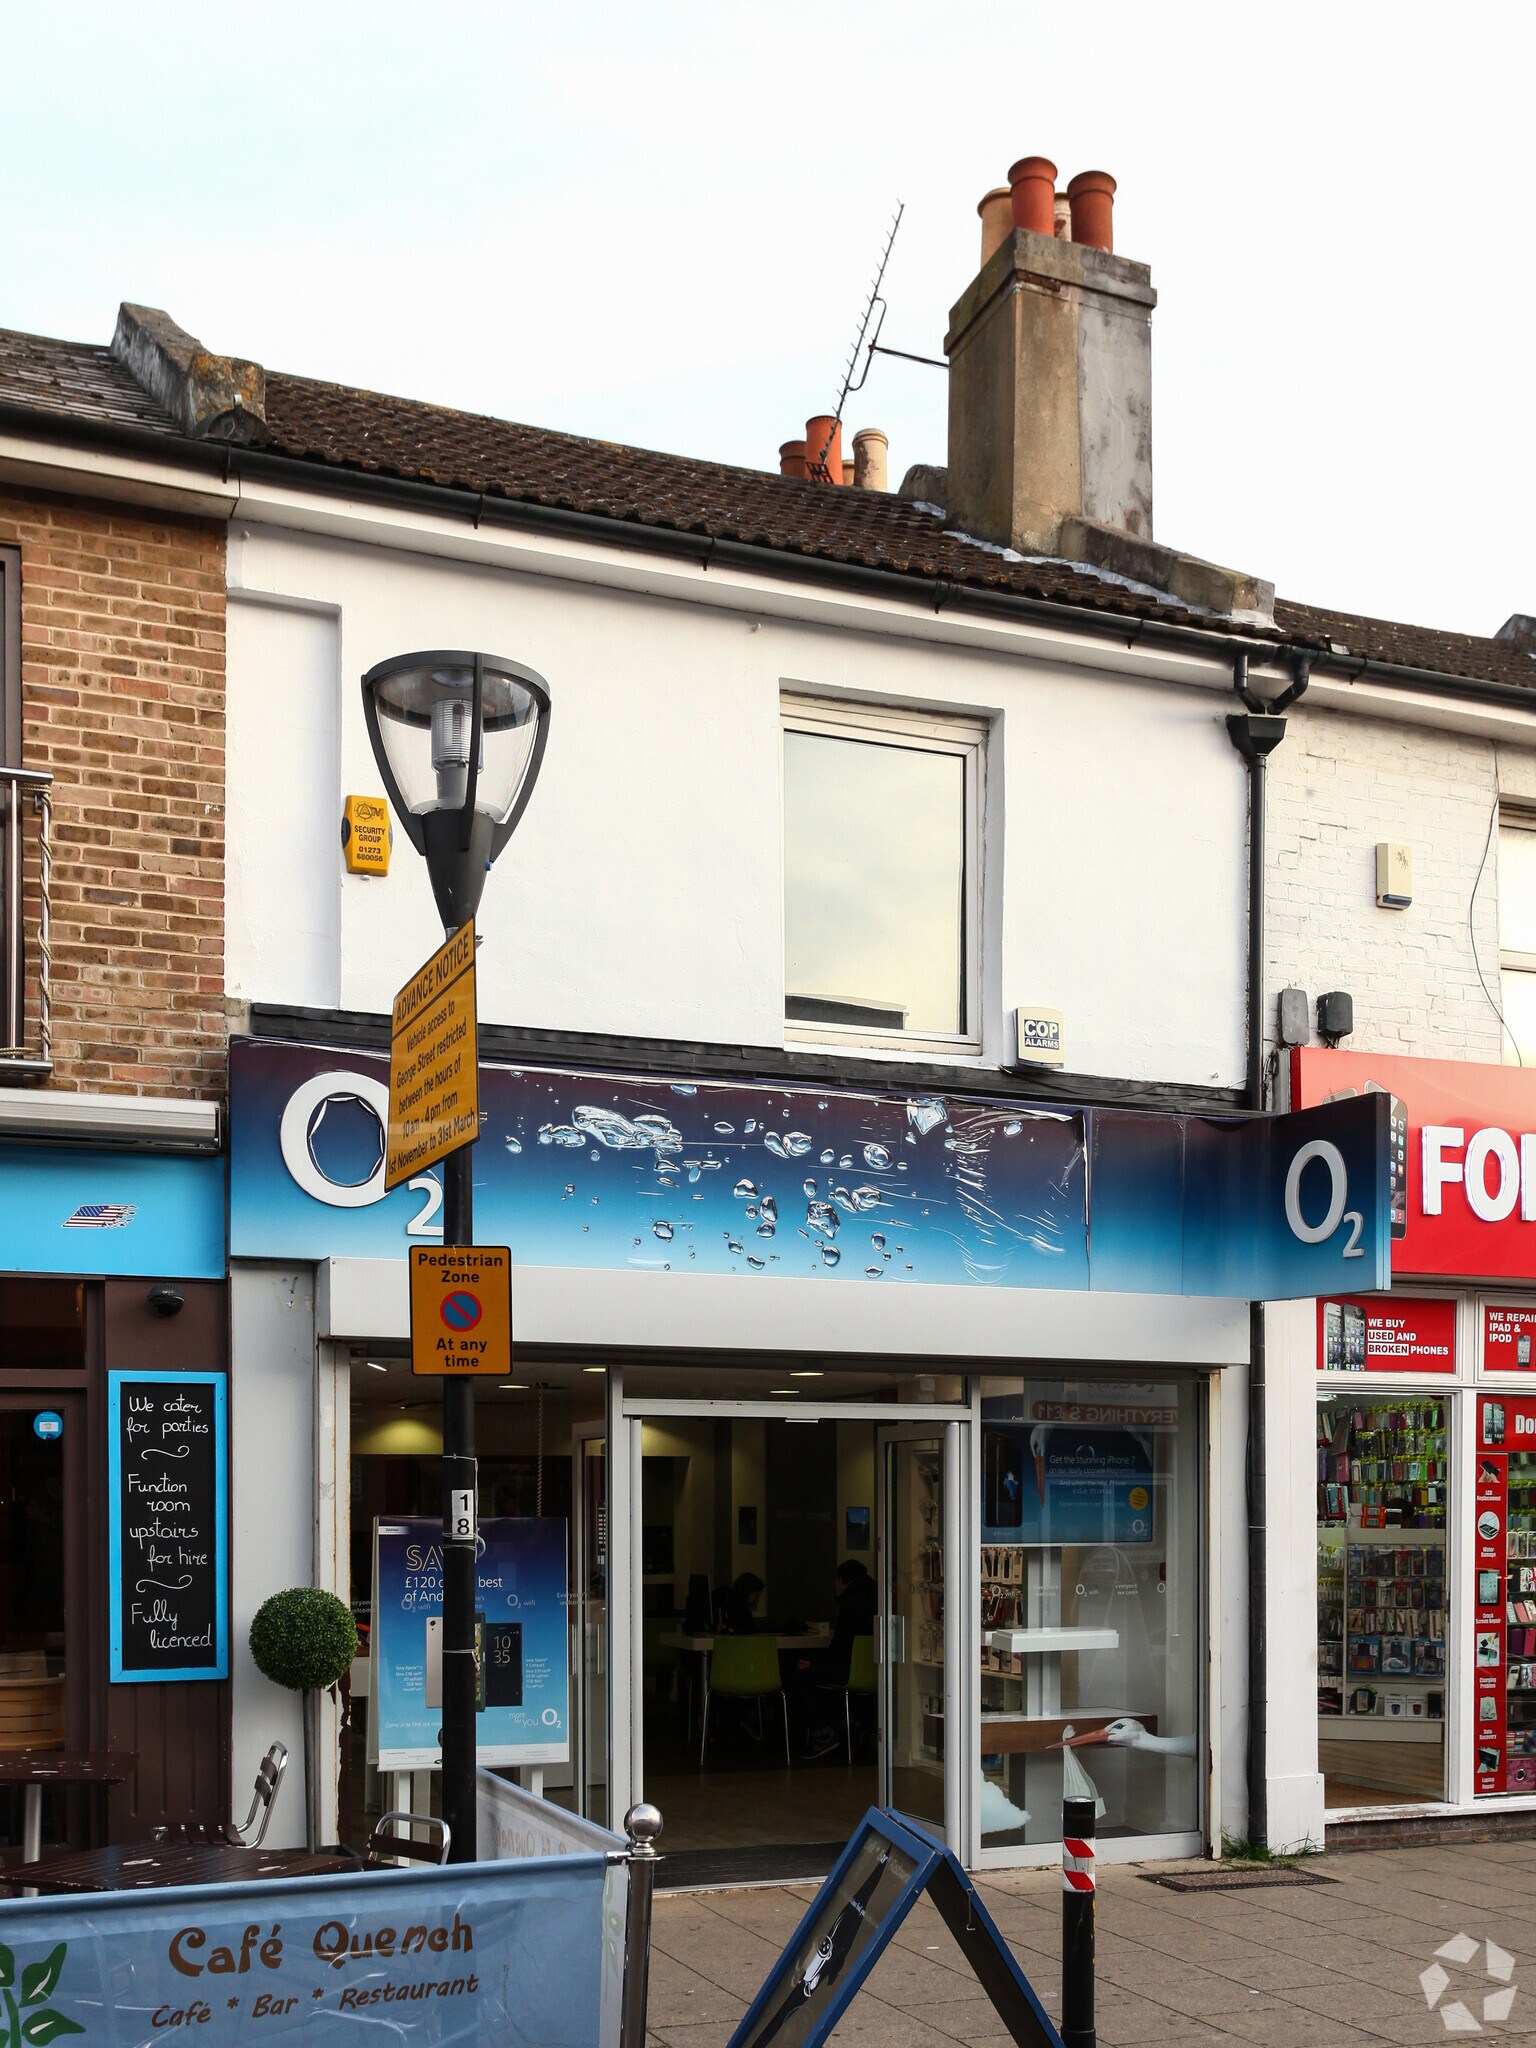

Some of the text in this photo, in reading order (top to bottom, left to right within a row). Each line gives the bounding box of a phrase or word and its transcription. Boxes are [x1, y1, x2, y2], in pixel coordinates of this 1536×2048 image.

[354, 825, 386, 835] SECURITY
[358, 833, 382, 843] GROUP
[358, 846, 381, 854] 01273
[395, 931, 469, 1025] ADVANCE NOTICE
[406, 999, 455, 1053] Vehicle access to
[1024, 1020, 1058, 1038] COP
[1025, 1038, 1059, 1049] ALARMS
[396, 1016, 467, 1089] George Street restricted
[398, 1052, 462, 1115] between the hours of
[442, 1091, 458, 1114] from
[388, 1107, 476, 1176] 1st November to 31st March
[1285, 1139, 1365, 1258] O2
[418, 1253, 503, 1267] Pedestrian
[441, 1270, 480, 1283] Zone
[1368, 1319, 1406, 1328] WE BUY
[1489, 1312, 1504, 1321] WE
[1489, 1323, 1521, 1333] IPAD &
[1369, 1331, 1416, 1341] USED AND
[1489, 1333, 1512, 1343] IPOD
[436, 1338, 488, 1353] At any
[1368, 1344, 1449, 1355] BROKEN PHONES
[444, 1355, 480, 1367] time
[129, 1393, 202, 1413] We cater
[126, 1415, 209, 1443] for parties
[1515, 1414, 1536, 1434] Do
[1049, 1454, 1062, 1464] Get
[1063, 1455, 1075, 1464] the
[1076, 1455, 1105, 1467] stunning
[1107, 1455, 1130, 1465] iPhone
[128, 1472, 188, 1493] Function
[146, 1500, 191, 1511] room
[129, 1517, 199, 1550] upstairs
[146, 1544, 208, 1572] for hire
[405, 1576, 436, 1588] £120
[478, 1575, 503, 1588] best
[404, 1589, 417, 1602] of
[131, 1598, 178, 1631] Fully
[150, 1623, 212, 1649] licenced
[494, 1635, 511, 1649] 10
[493, 1650, 511, 1664] 35
[541, 1708, 562, 1729] O2
[168, 1913, 474, 1977] Café Quench
[151, 1973, 480, 2028] Café Bar Restaurant
